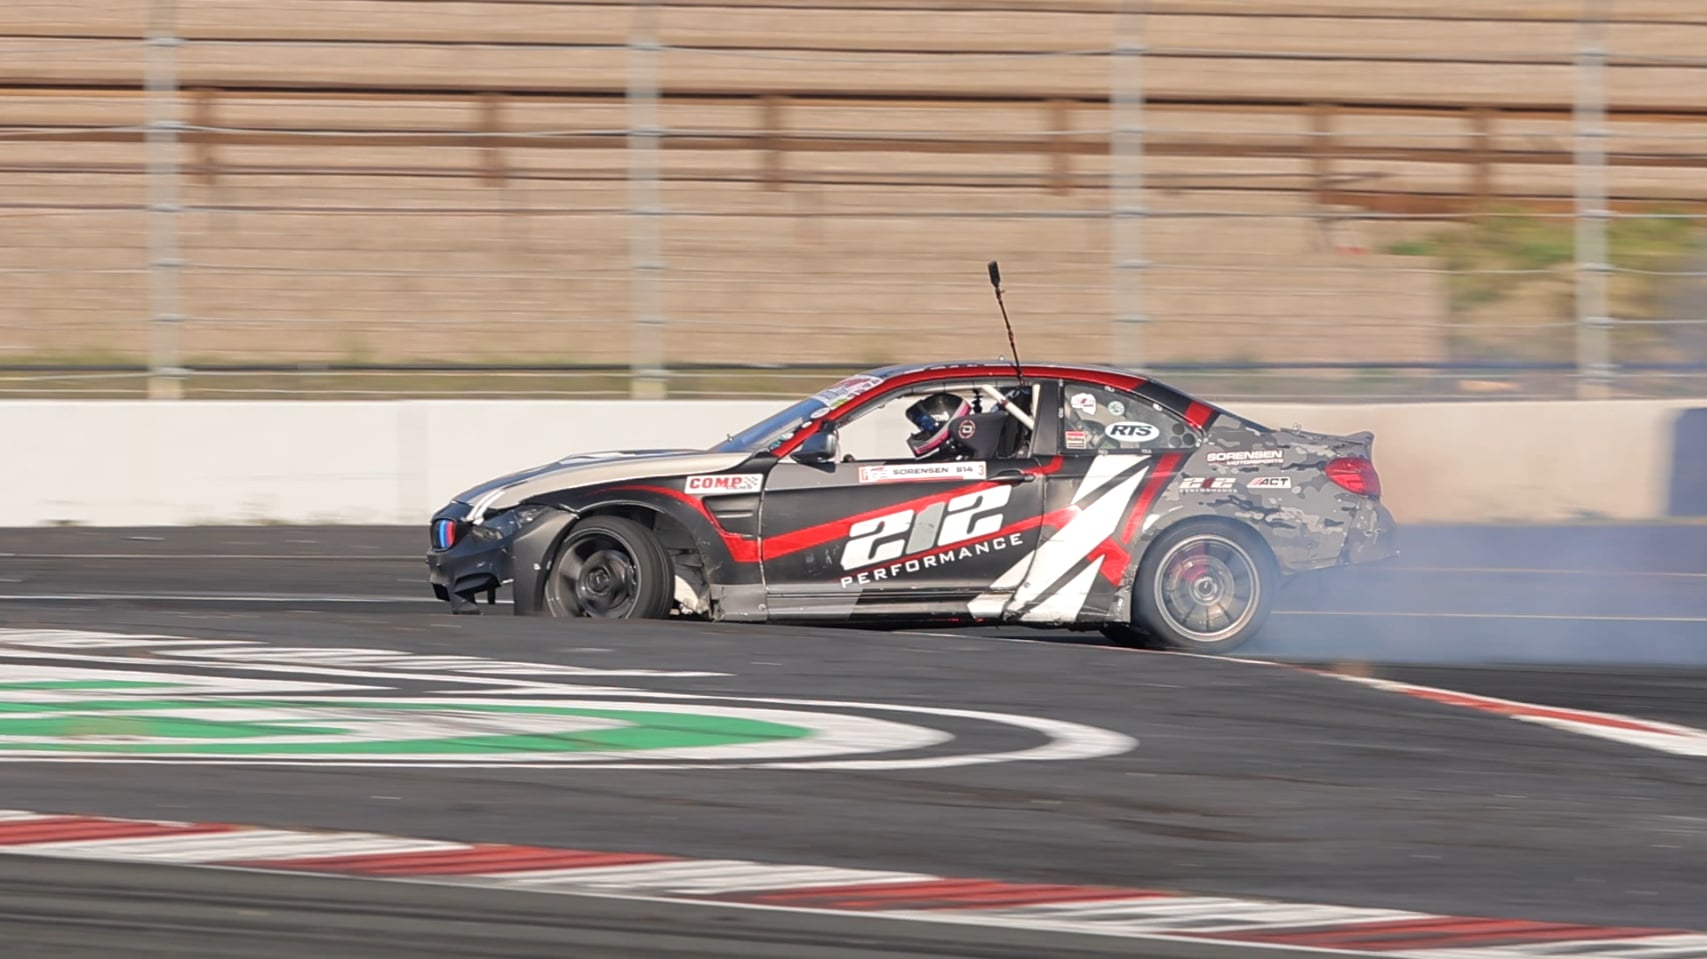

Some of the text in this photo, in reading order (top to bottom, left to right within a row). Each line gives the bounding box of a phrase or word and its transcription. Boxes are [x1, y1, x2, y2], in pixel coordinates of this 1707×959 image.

[1110, 425, 1152, 436] RTS
[1207, 451, 1282, 462] SORENSEN
[893, 467, 949, 475] SORENSEN
[689, 477, 743, 489] COMP
[1180, 478, 1236, 489] 212
[1260, 478, 1288, 486] ACT
[840, 484, 1012, 571] 212
[840, 533, 1023, 588] PERFORMANCE
